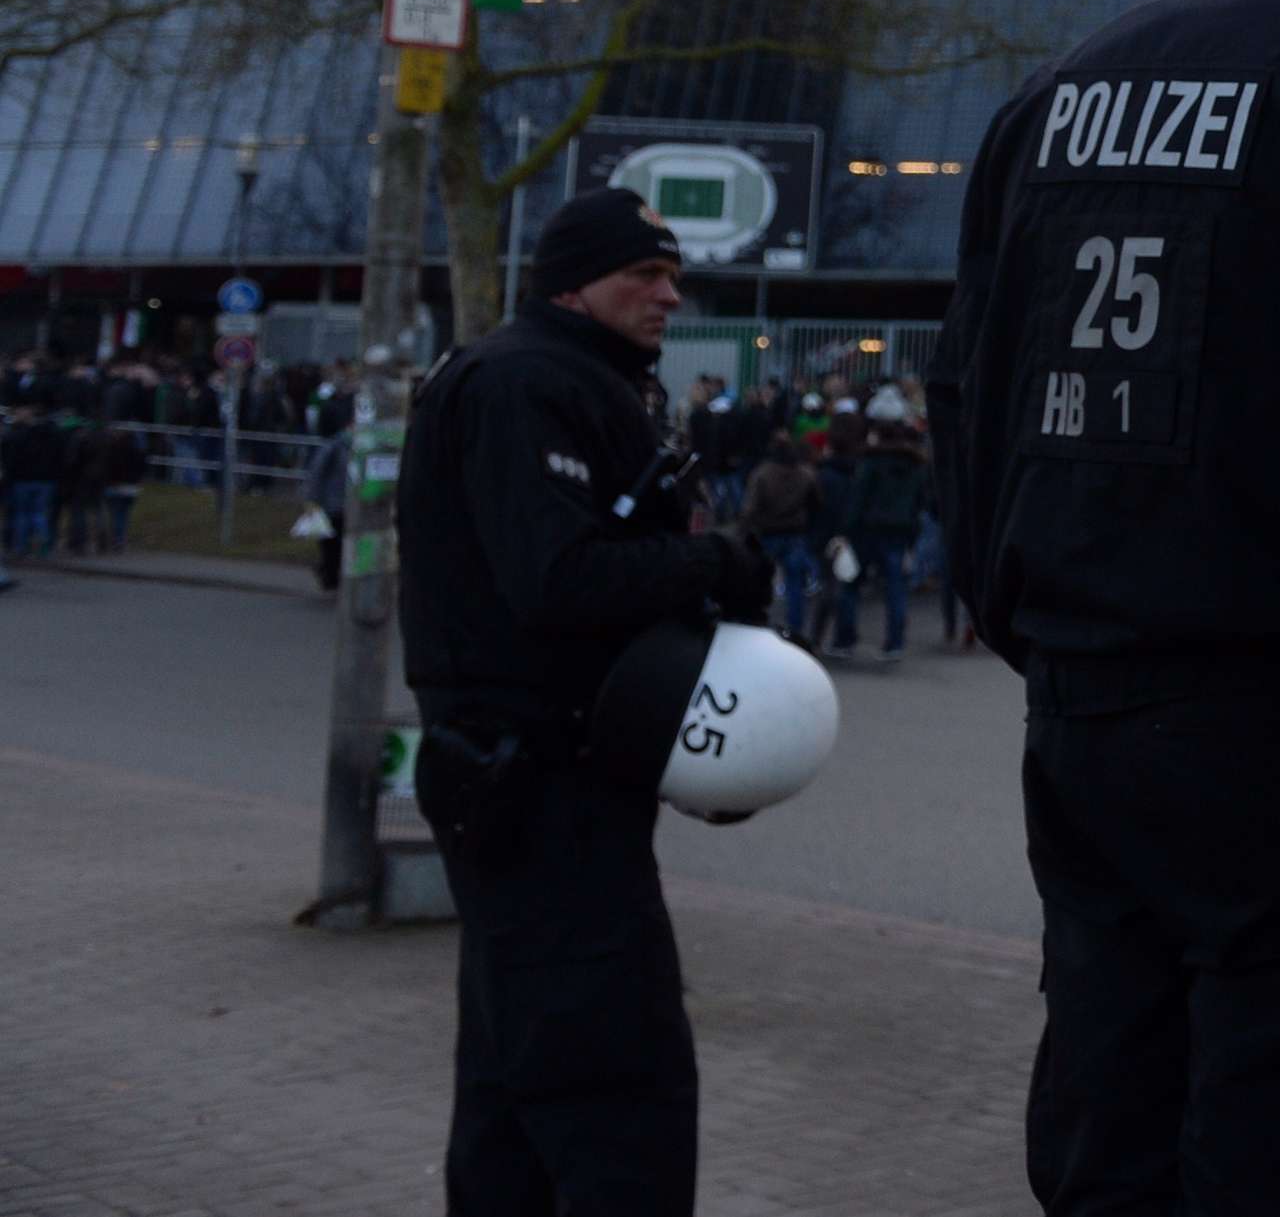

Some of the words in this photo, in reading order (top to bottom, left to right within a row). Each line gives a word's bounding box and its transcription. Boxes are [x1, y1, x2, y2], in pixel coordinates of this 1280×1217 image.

[1037, 80, 1259, 171] POLIZEI
[1070, 235, 1165, 350] 25
[1041, 370, 1086, 437] HB
[1112, 379, 1130, 434] 1
